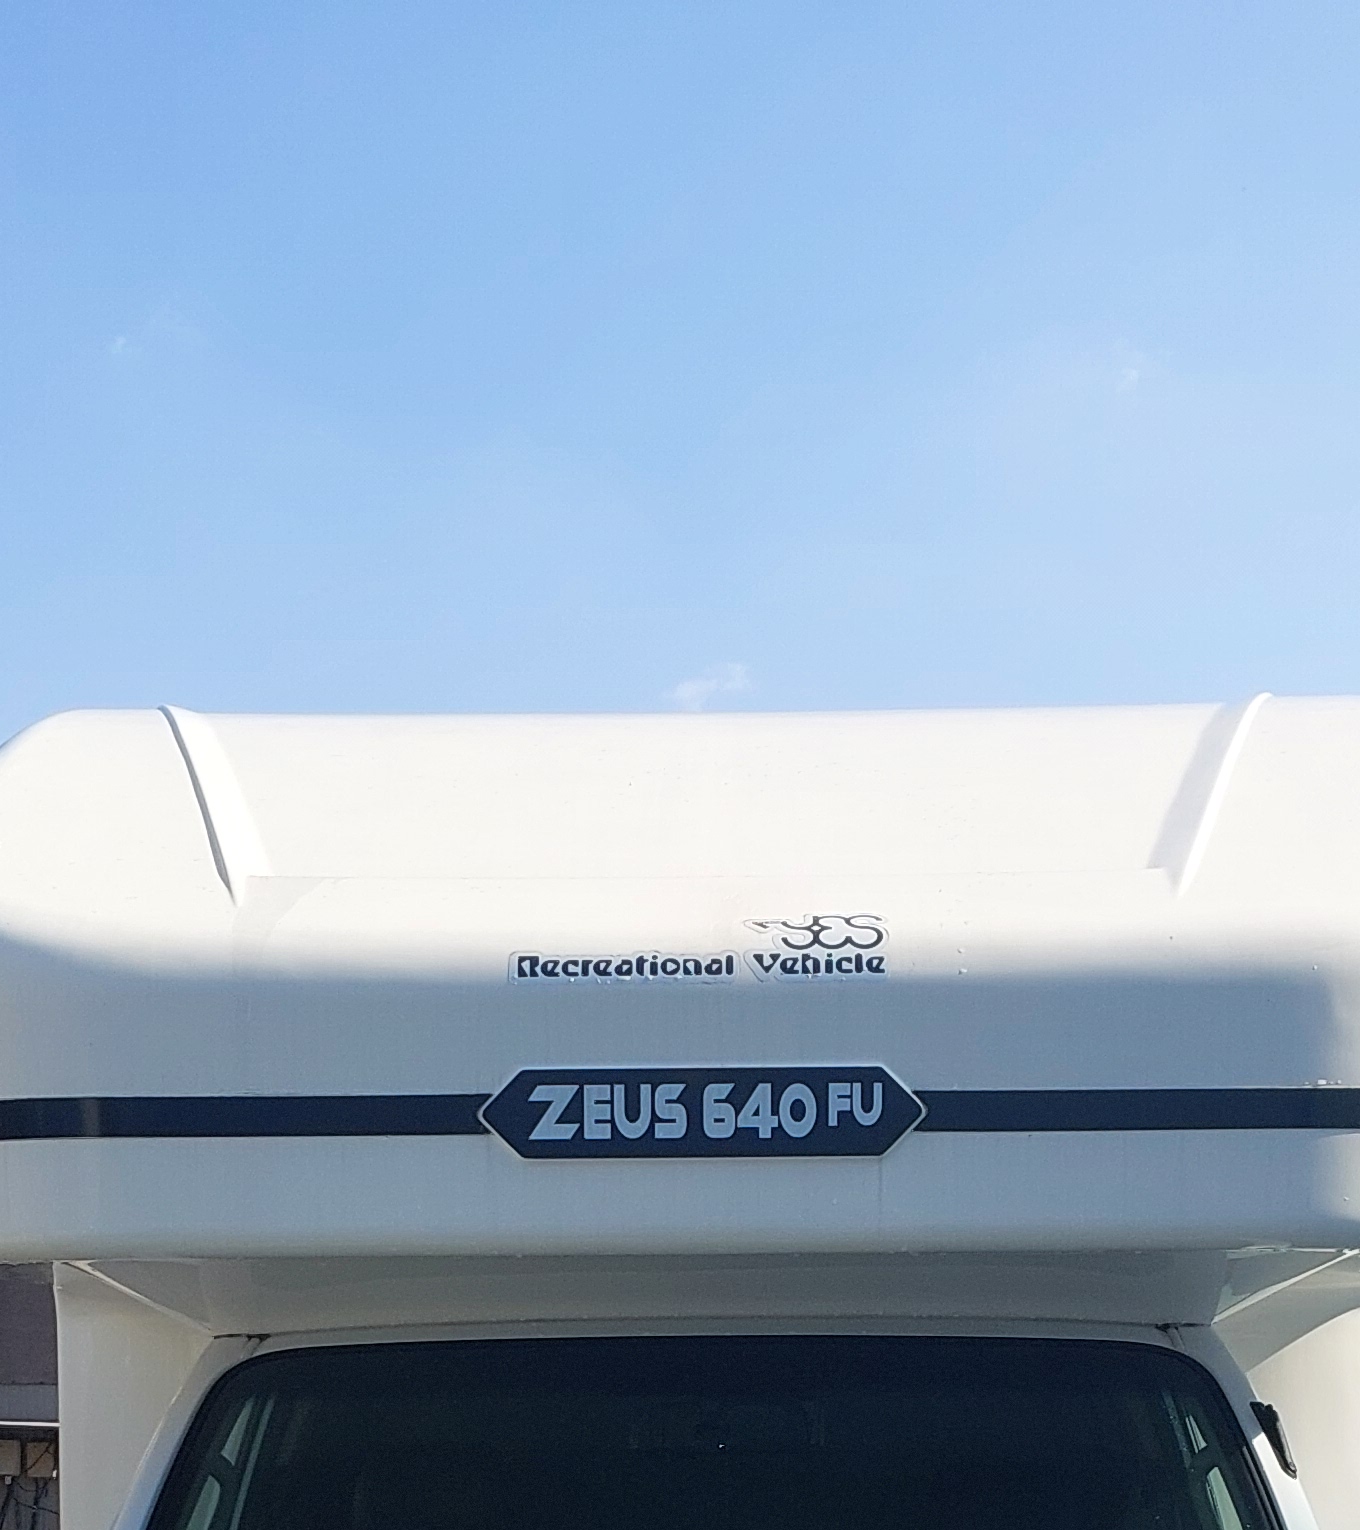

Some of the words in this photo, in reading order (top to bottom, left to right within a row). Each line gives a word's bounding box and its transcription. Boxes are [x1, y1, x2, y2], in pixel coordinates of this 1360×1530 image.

[517, 954, 735, 978] Recreational
[752, 952, 886, 975] Vehicle
[527, 1083, 688, 1140] ZEUS
[702, 1082, 817, 1139] 640
[827, 1082, 883, 1126] FU
